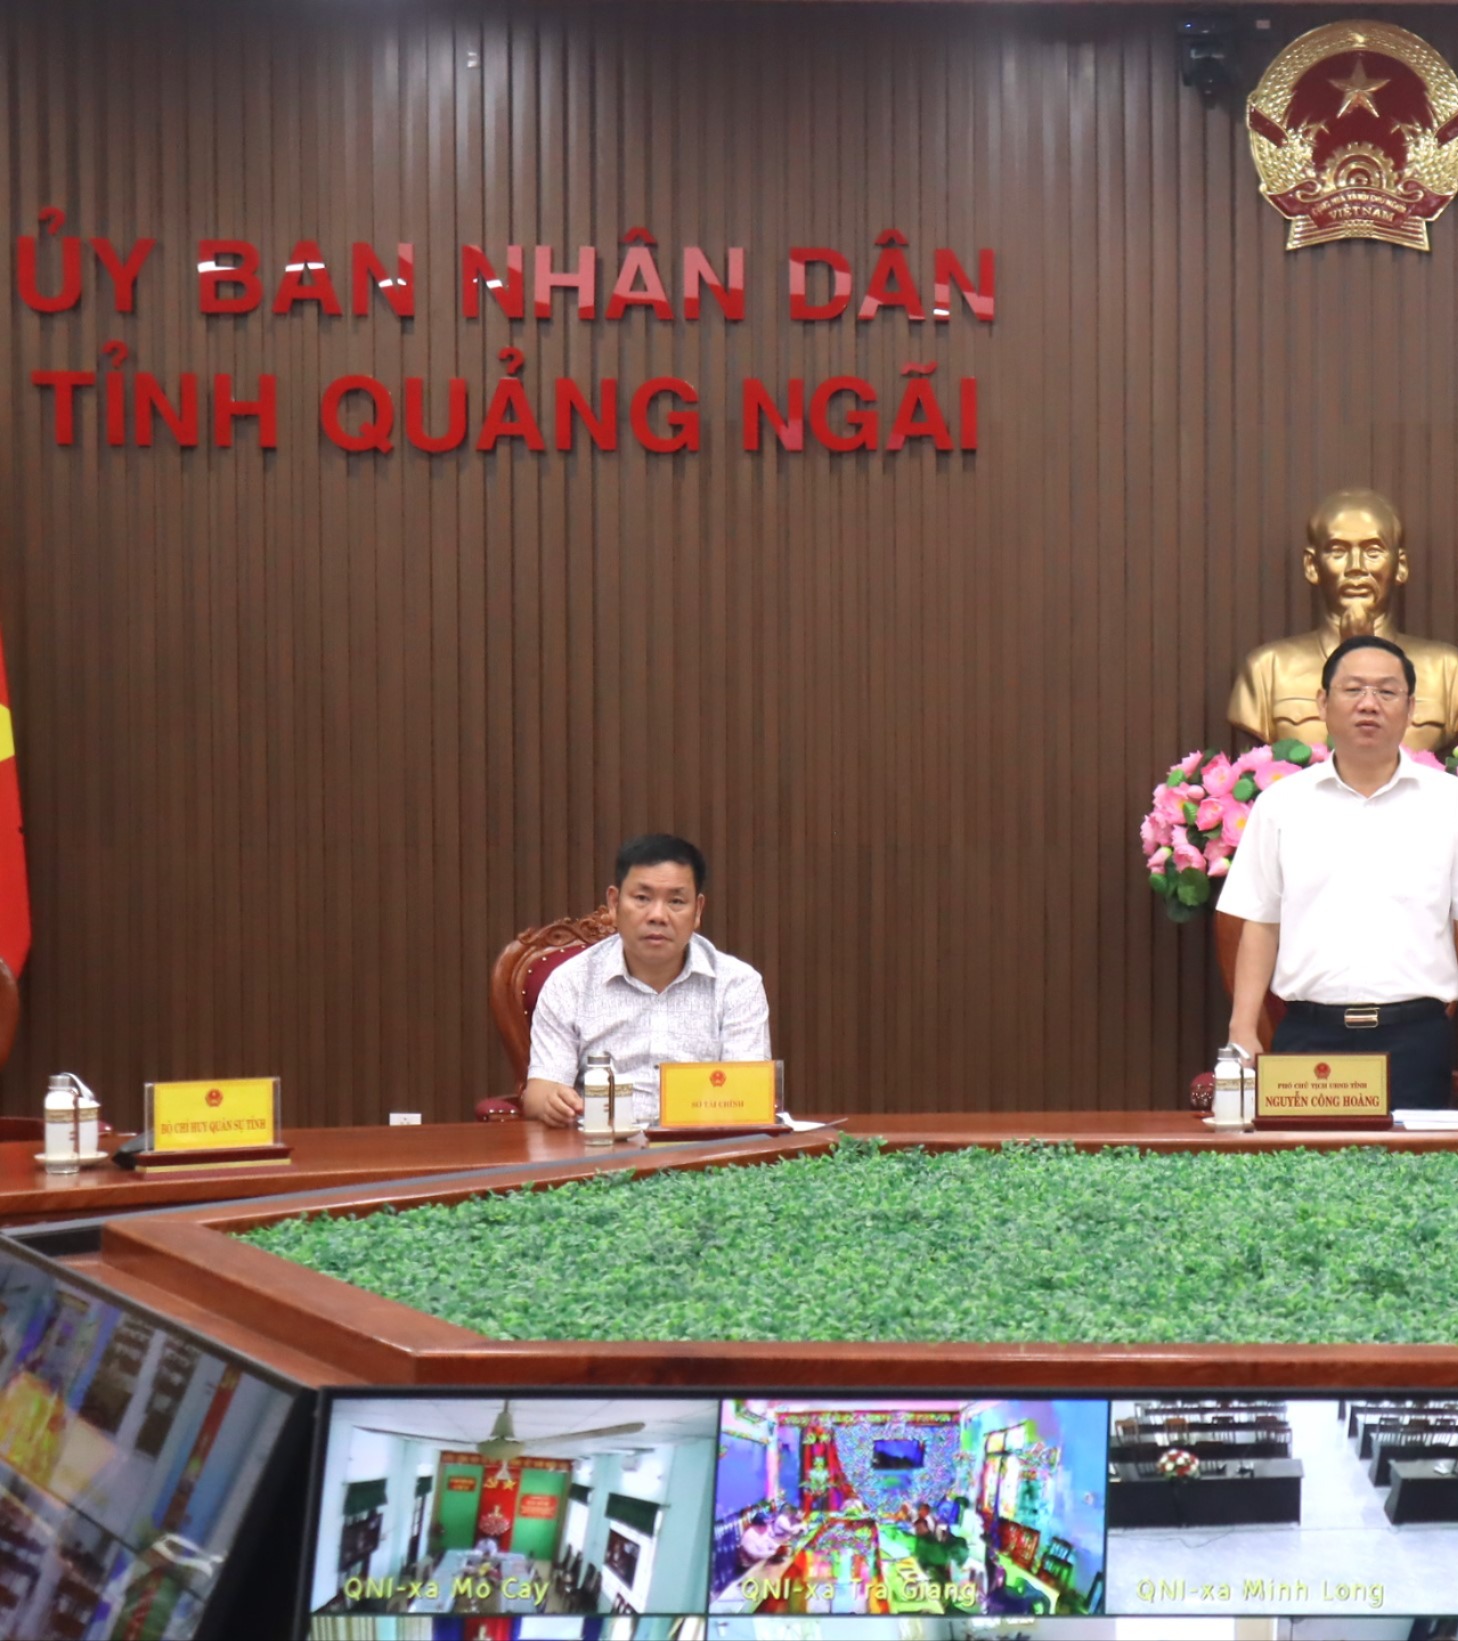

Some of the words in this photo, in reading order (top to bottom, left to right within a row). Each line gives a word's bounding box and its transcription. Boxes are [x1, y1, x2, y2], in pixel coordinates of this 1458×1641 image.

[17, 207, 157, 314] ỦY
[197, 239, 415, 318] BAN
[462, 227, 745, 321] NHÂN
[789, 229, 996, 322] DÂN
[31, 340, 278, 449] TỈNH
[321, 347, 700, 454] QUẢNG
[742, 361, 978, 453] NGÃI
[1265, 1091, 1308, 1107] NGUYỄN
[1310, 1093, 1340, 1107] CÔNG
[1343, 1092, 1380, 1107] HOÀNG
[1278, 1081, 1292, 1089] PHÓ
[191, 1120, 208, 1133] HUY
[344, 1577, 439, 1601] QNI-xa
[501, 1577, 550, 1606] Cay
[741, 1577, 834, 1601] QNI-xa
[849, 1578, 888, 1600] Tra
[901, 1578, 977, 1606] Giang
[1136, 1577, 1231, 1604] QNI-xa
[1243, 1578, 1309, 1601] Minh
[1322, 1579, 1385, 1608] Long
